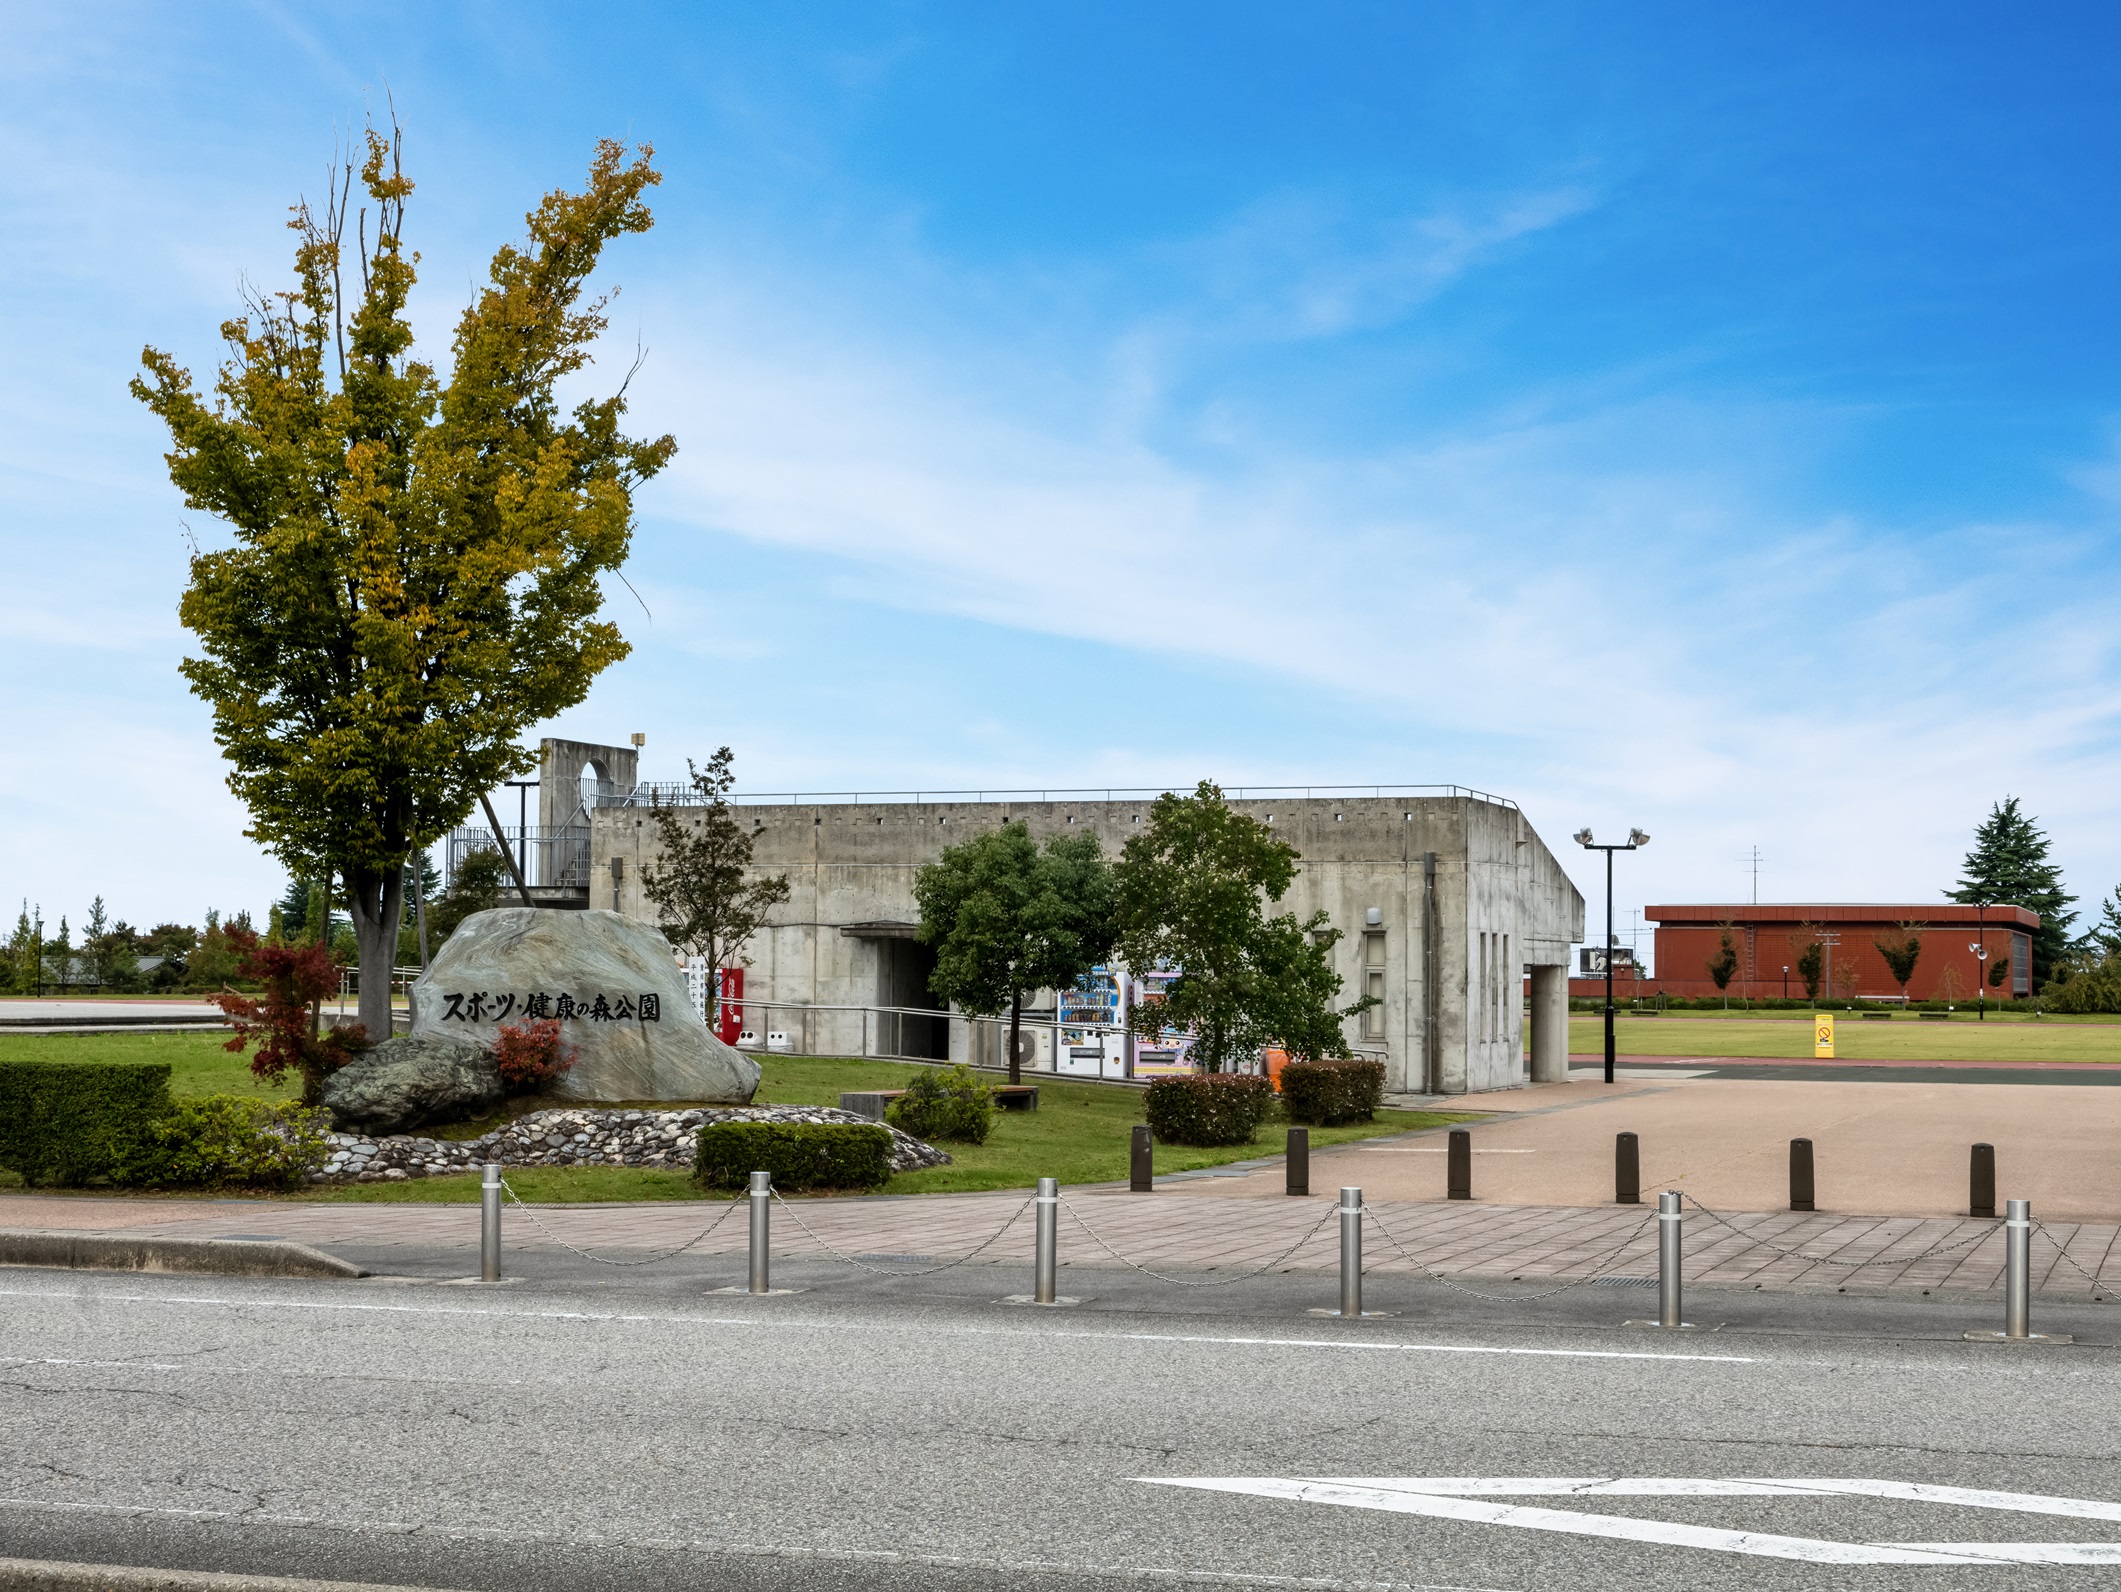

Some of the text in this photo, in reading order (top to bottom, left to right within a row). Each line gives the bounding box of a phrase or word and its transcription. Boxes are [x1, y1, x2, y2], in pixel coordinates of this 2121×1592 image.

[441, 991, 660, 1023] スポーツ・健康の森公園
